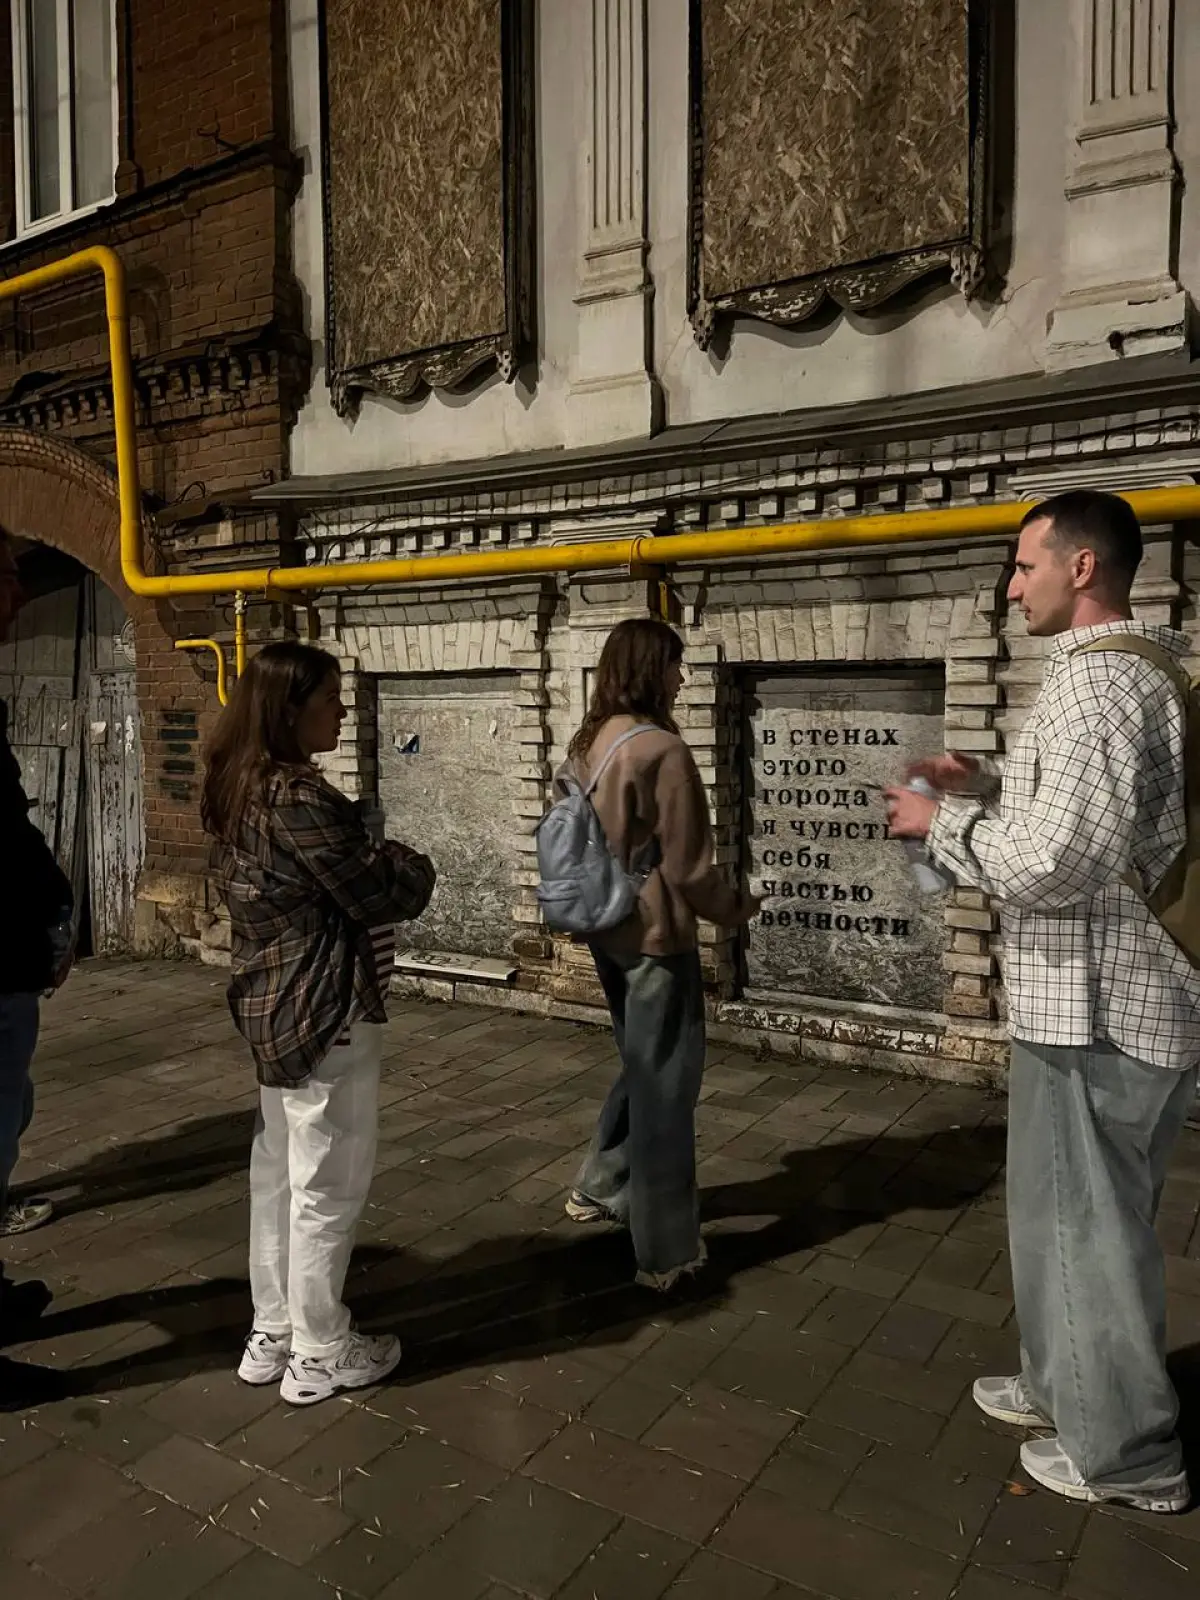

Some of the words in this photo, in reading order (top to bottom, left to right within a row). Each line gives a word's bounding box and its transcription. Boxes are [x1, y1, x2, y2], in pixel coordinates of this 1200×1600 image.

[763, 729, 776, 745] в
[790, 729, 899, 746] стенах
[763, 759, 846, 776] этого
[763, 788, 868, 809] города
[761, 820, 776, 835] я
[790, 820, 898, 840] чувст
[763, 846, 831, 869] себя
[762, 879, 873, 902] частью
[760, 910, 910, 936] вечности
